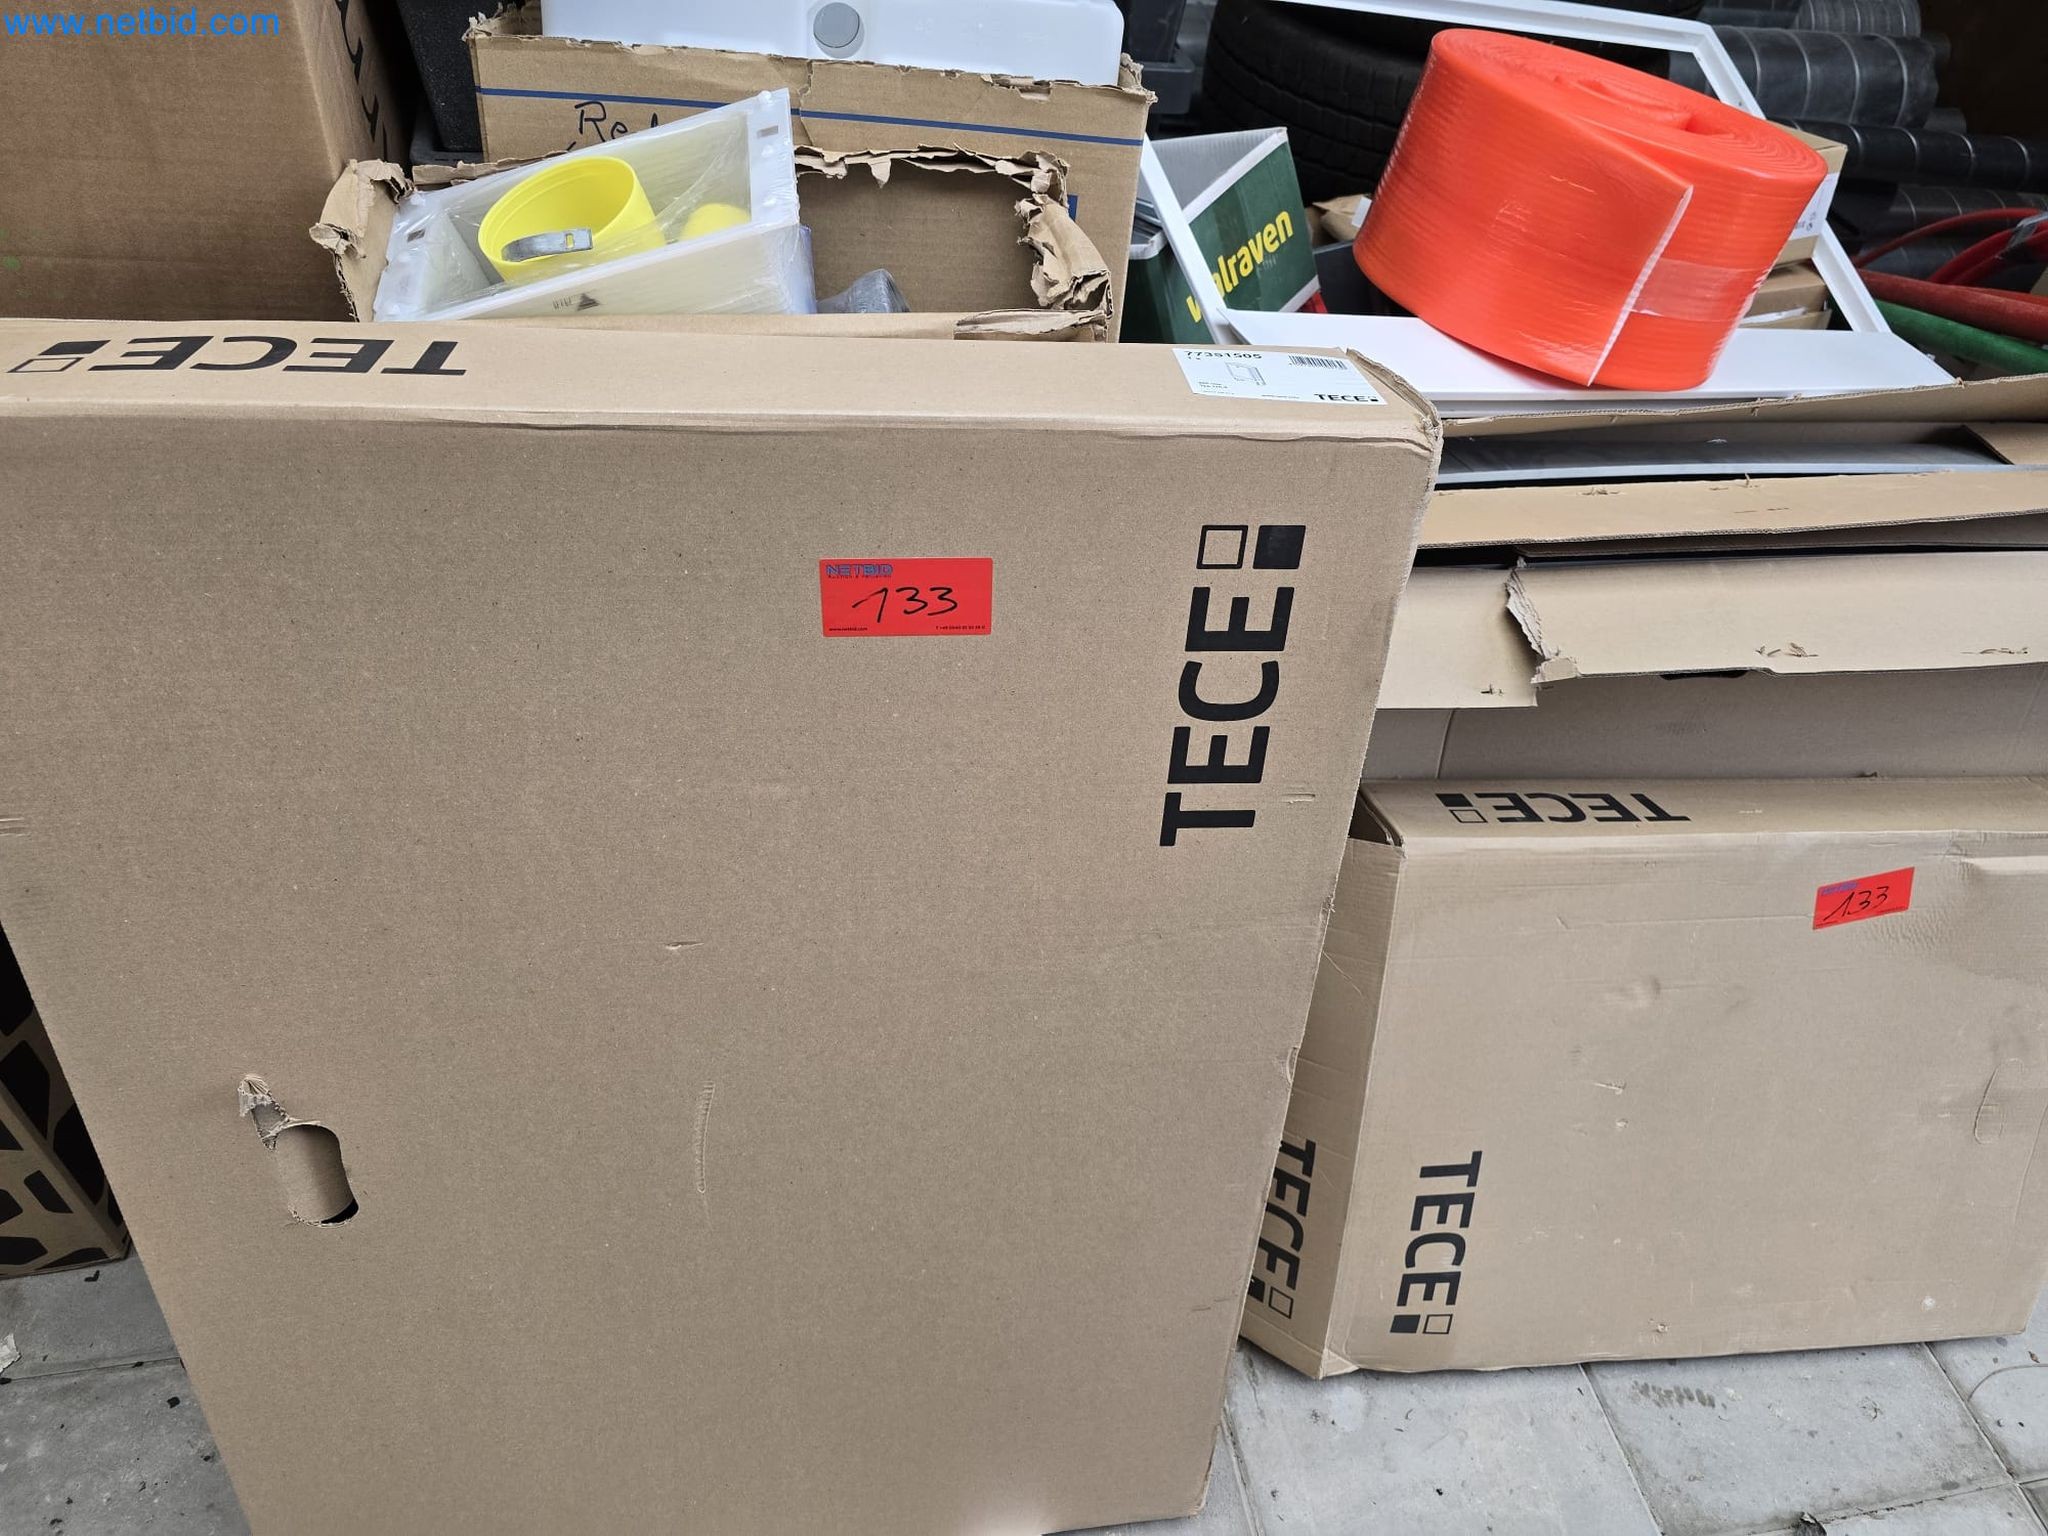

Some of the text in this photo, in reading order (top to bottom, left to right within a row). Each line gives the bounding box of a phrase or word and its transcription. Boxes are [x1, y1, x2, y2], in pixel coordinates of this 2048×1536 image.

[87, 335, 467, 376] TECE
[1314, 393, 1369, 403] TECE
[826, 563, 894, 576] NETBID
[851, 586, 958, 624] 133
[1159, 586, 1295, 847] TECE
[1473, 792, 1692, 823] TECE
[1822, 885, 1890, 922] 133
[1396, 1150, 1483, 1308] TECE
